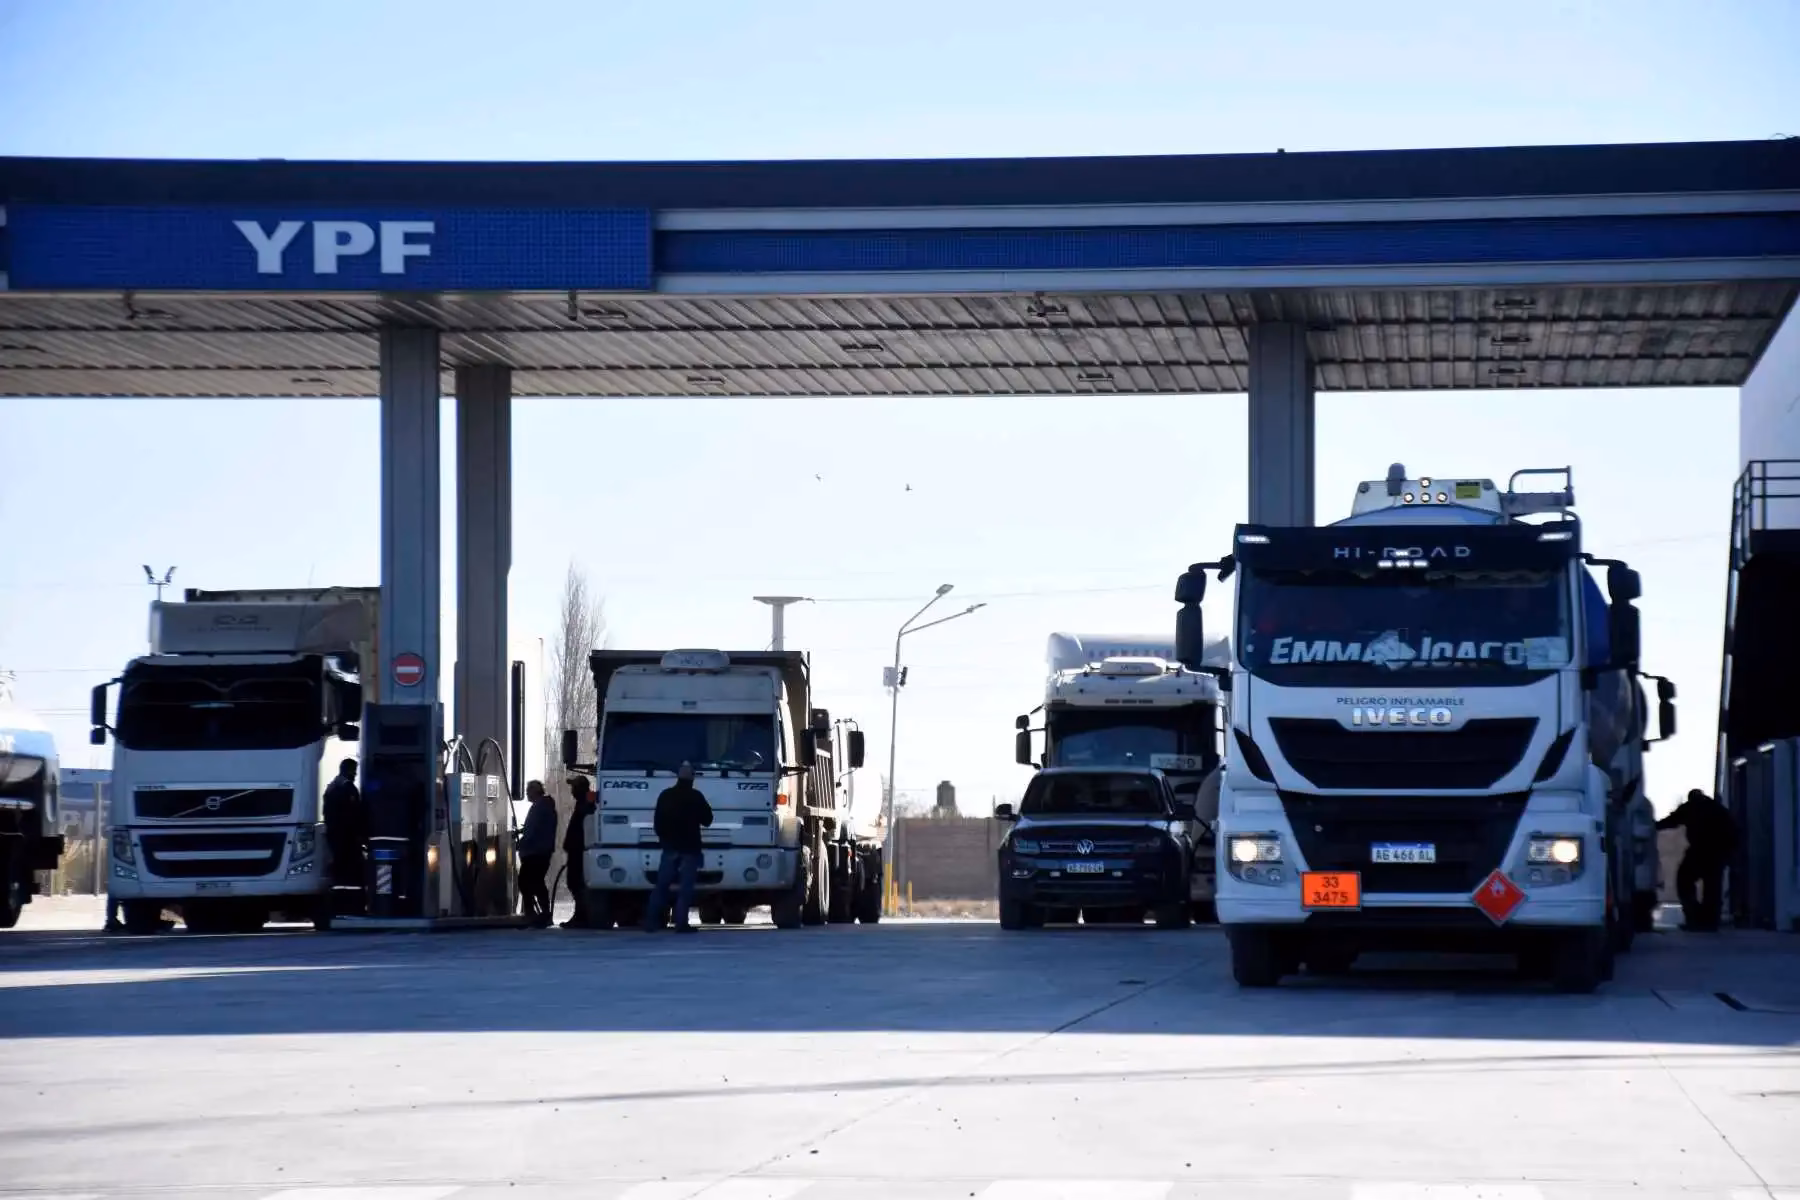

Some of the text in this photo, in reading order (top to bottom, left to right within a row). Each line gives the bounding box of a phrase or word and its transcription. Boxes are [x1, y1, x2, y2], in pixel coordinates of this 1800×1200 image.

[232, 220, 435, 274] YPF
[1333, 546, 1472, 558] HI-ROAD
[1336, 697, 1465, 706] PELIGRO INFLAMABLE
[1352, 707, 1452, 726] IVECO
[603, 780, 649, 790] CARGO
[1321, 876, 1339, 889] 33
[1312, 891, 1349, 904] 3475
